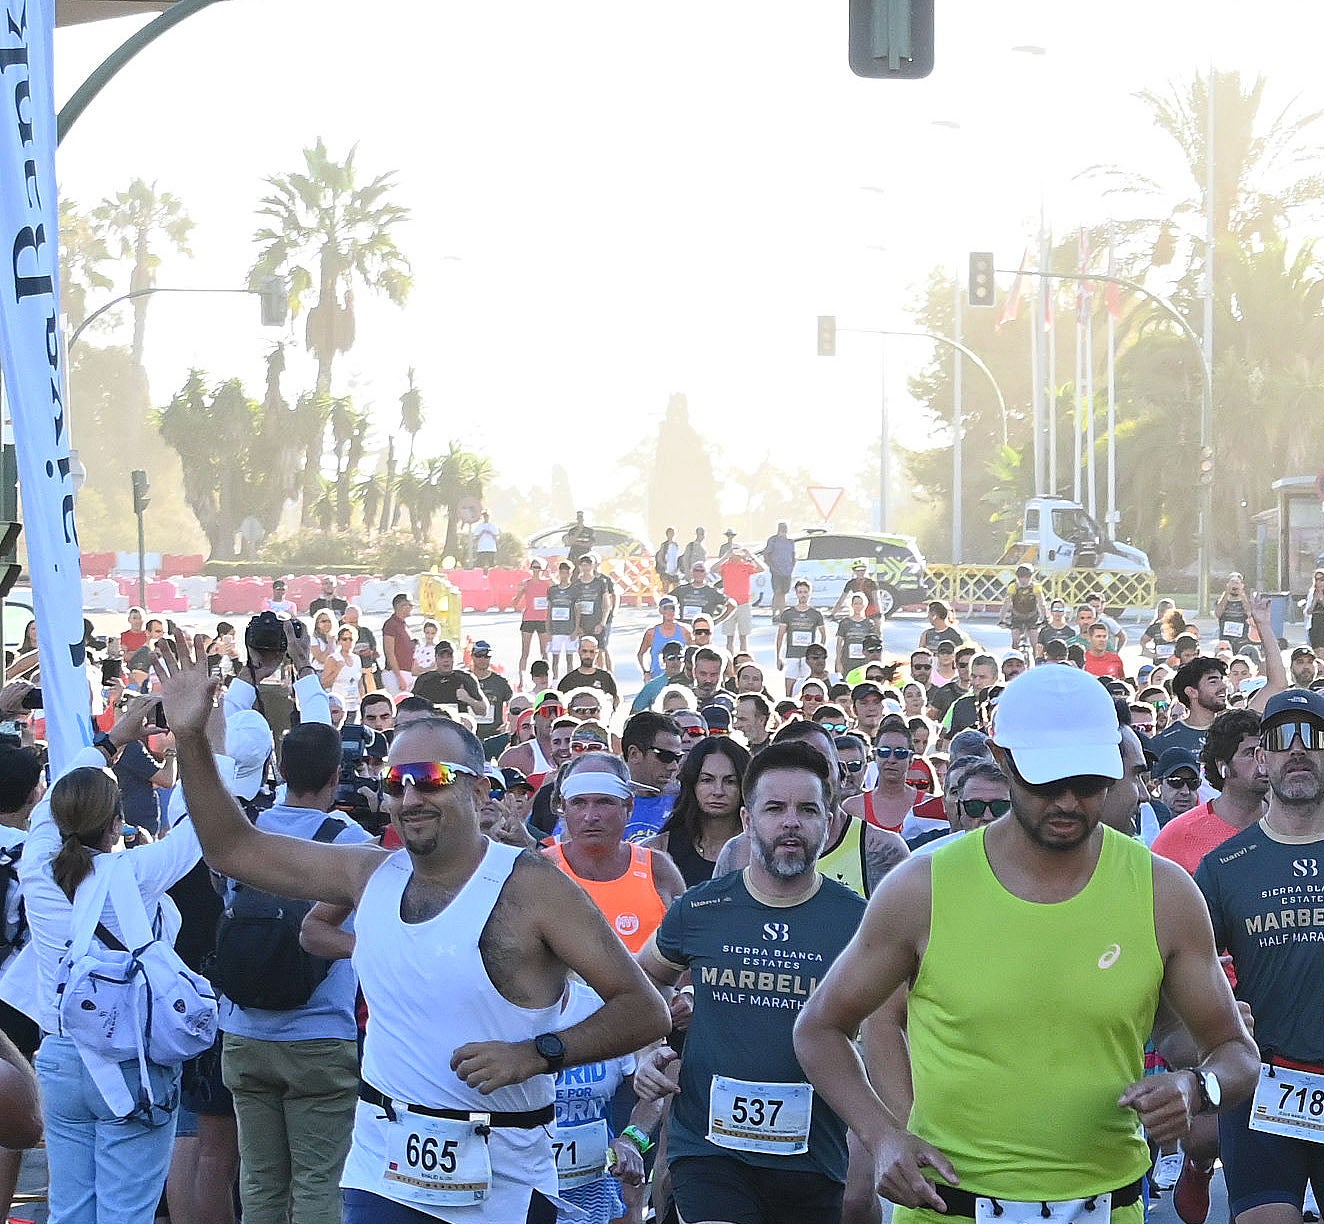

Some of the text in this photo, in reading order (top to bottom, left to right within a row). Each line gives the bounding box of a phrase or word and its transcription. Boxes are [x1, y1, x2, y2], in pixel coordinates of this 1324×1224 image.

[1261, 885, 1302, 898] SIERRA
[1259, 934, 1289, 948] HALF
[722, 945, 823, 962] SIERRA BLANCA
[743, 958, 800, 970] ESTATES
[712, 991, 745, 1004] HALF
[568, 1087, 592, 1099] POR
[732, 1096, 784, 1126] 537
[406, 1133, 459, 1173] 665
